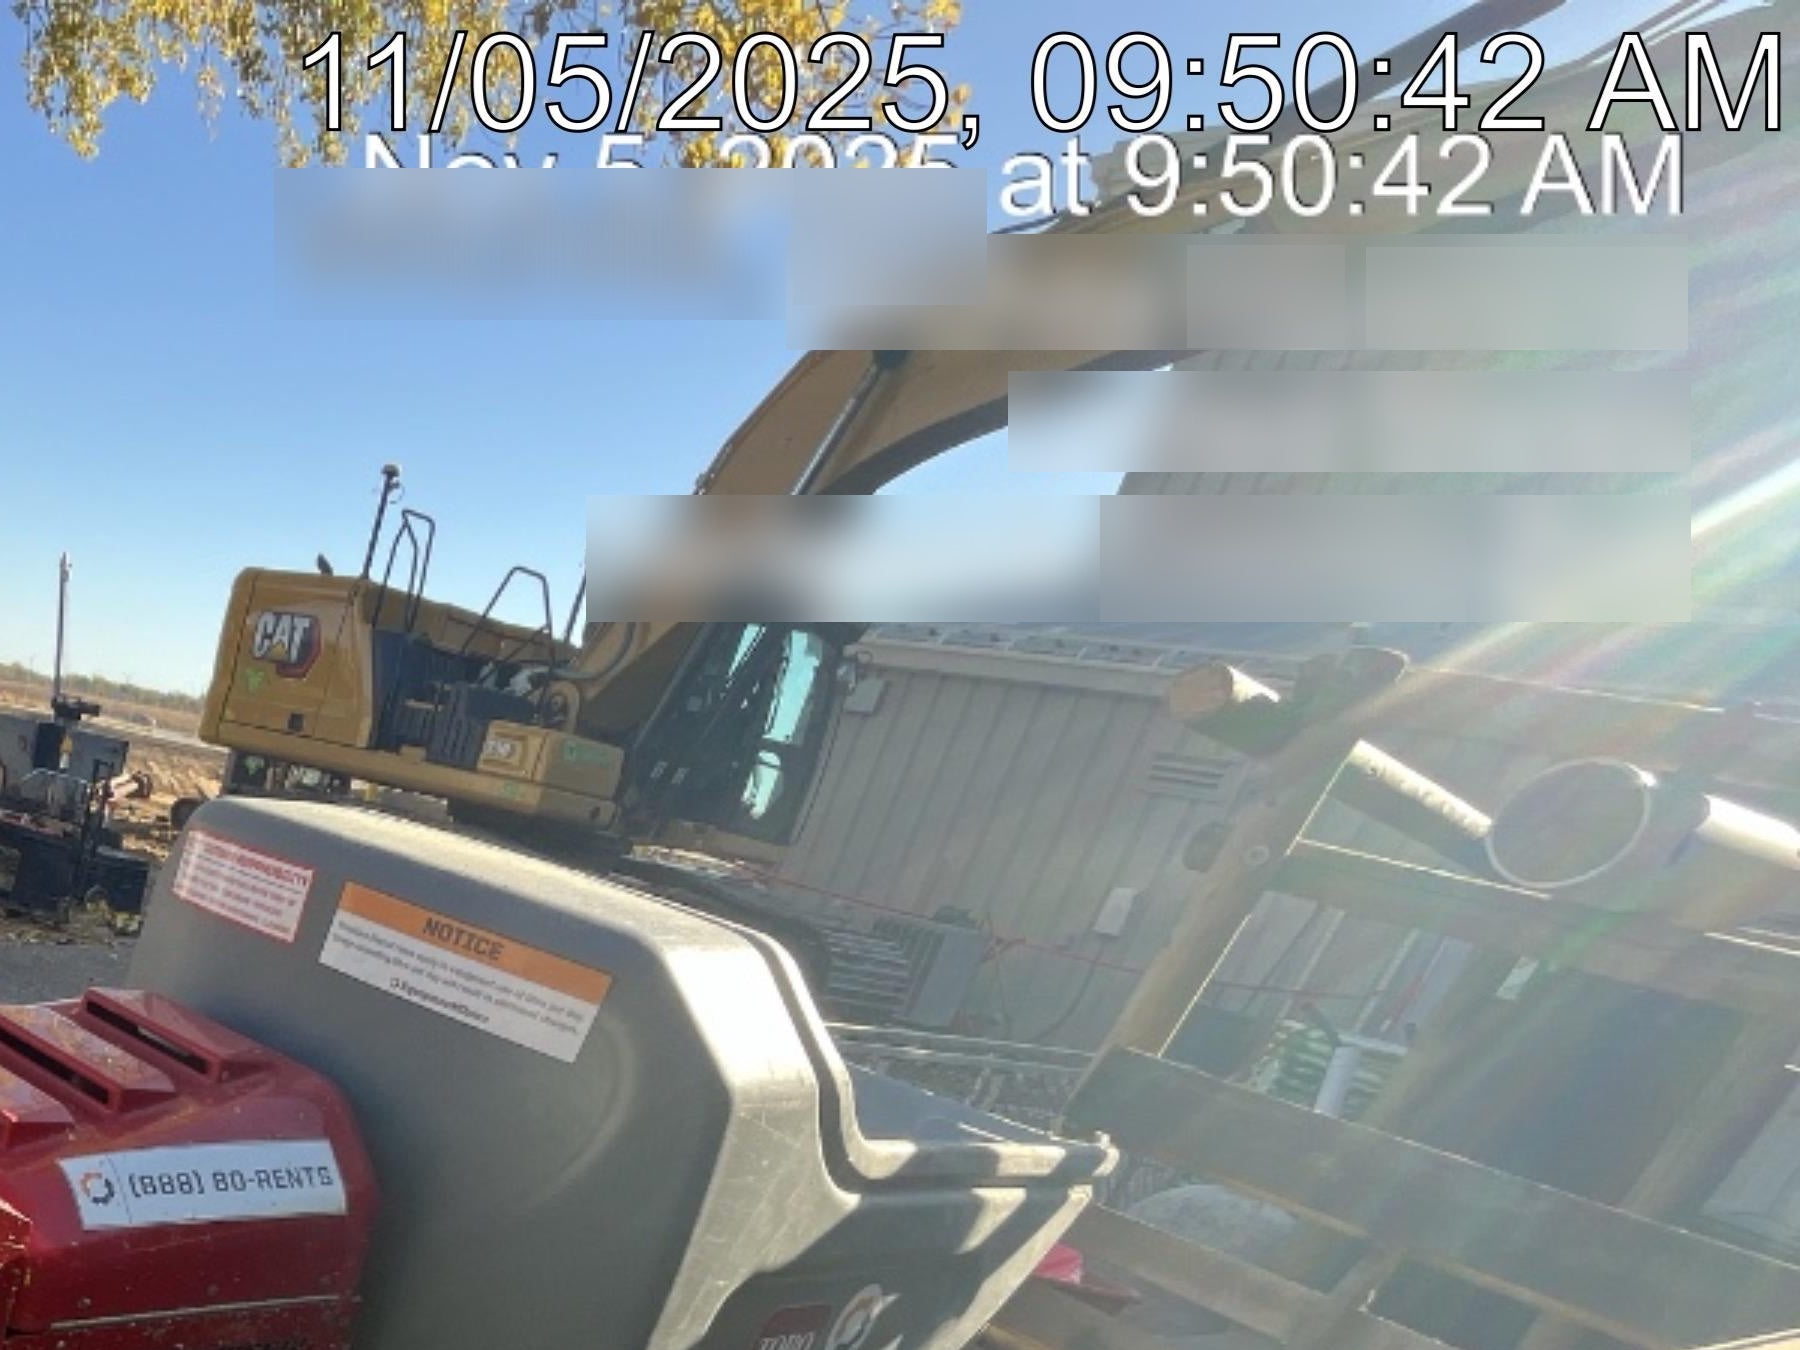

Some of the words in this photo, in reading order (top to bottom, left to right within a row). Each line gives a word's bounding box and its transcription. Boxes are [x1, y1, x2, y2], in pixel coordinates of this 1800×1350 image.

[253, 611, 311, 664] CAT
[423, 917, 504, 961] NOTICE
[128, 1169, 205, 1197] (888)
